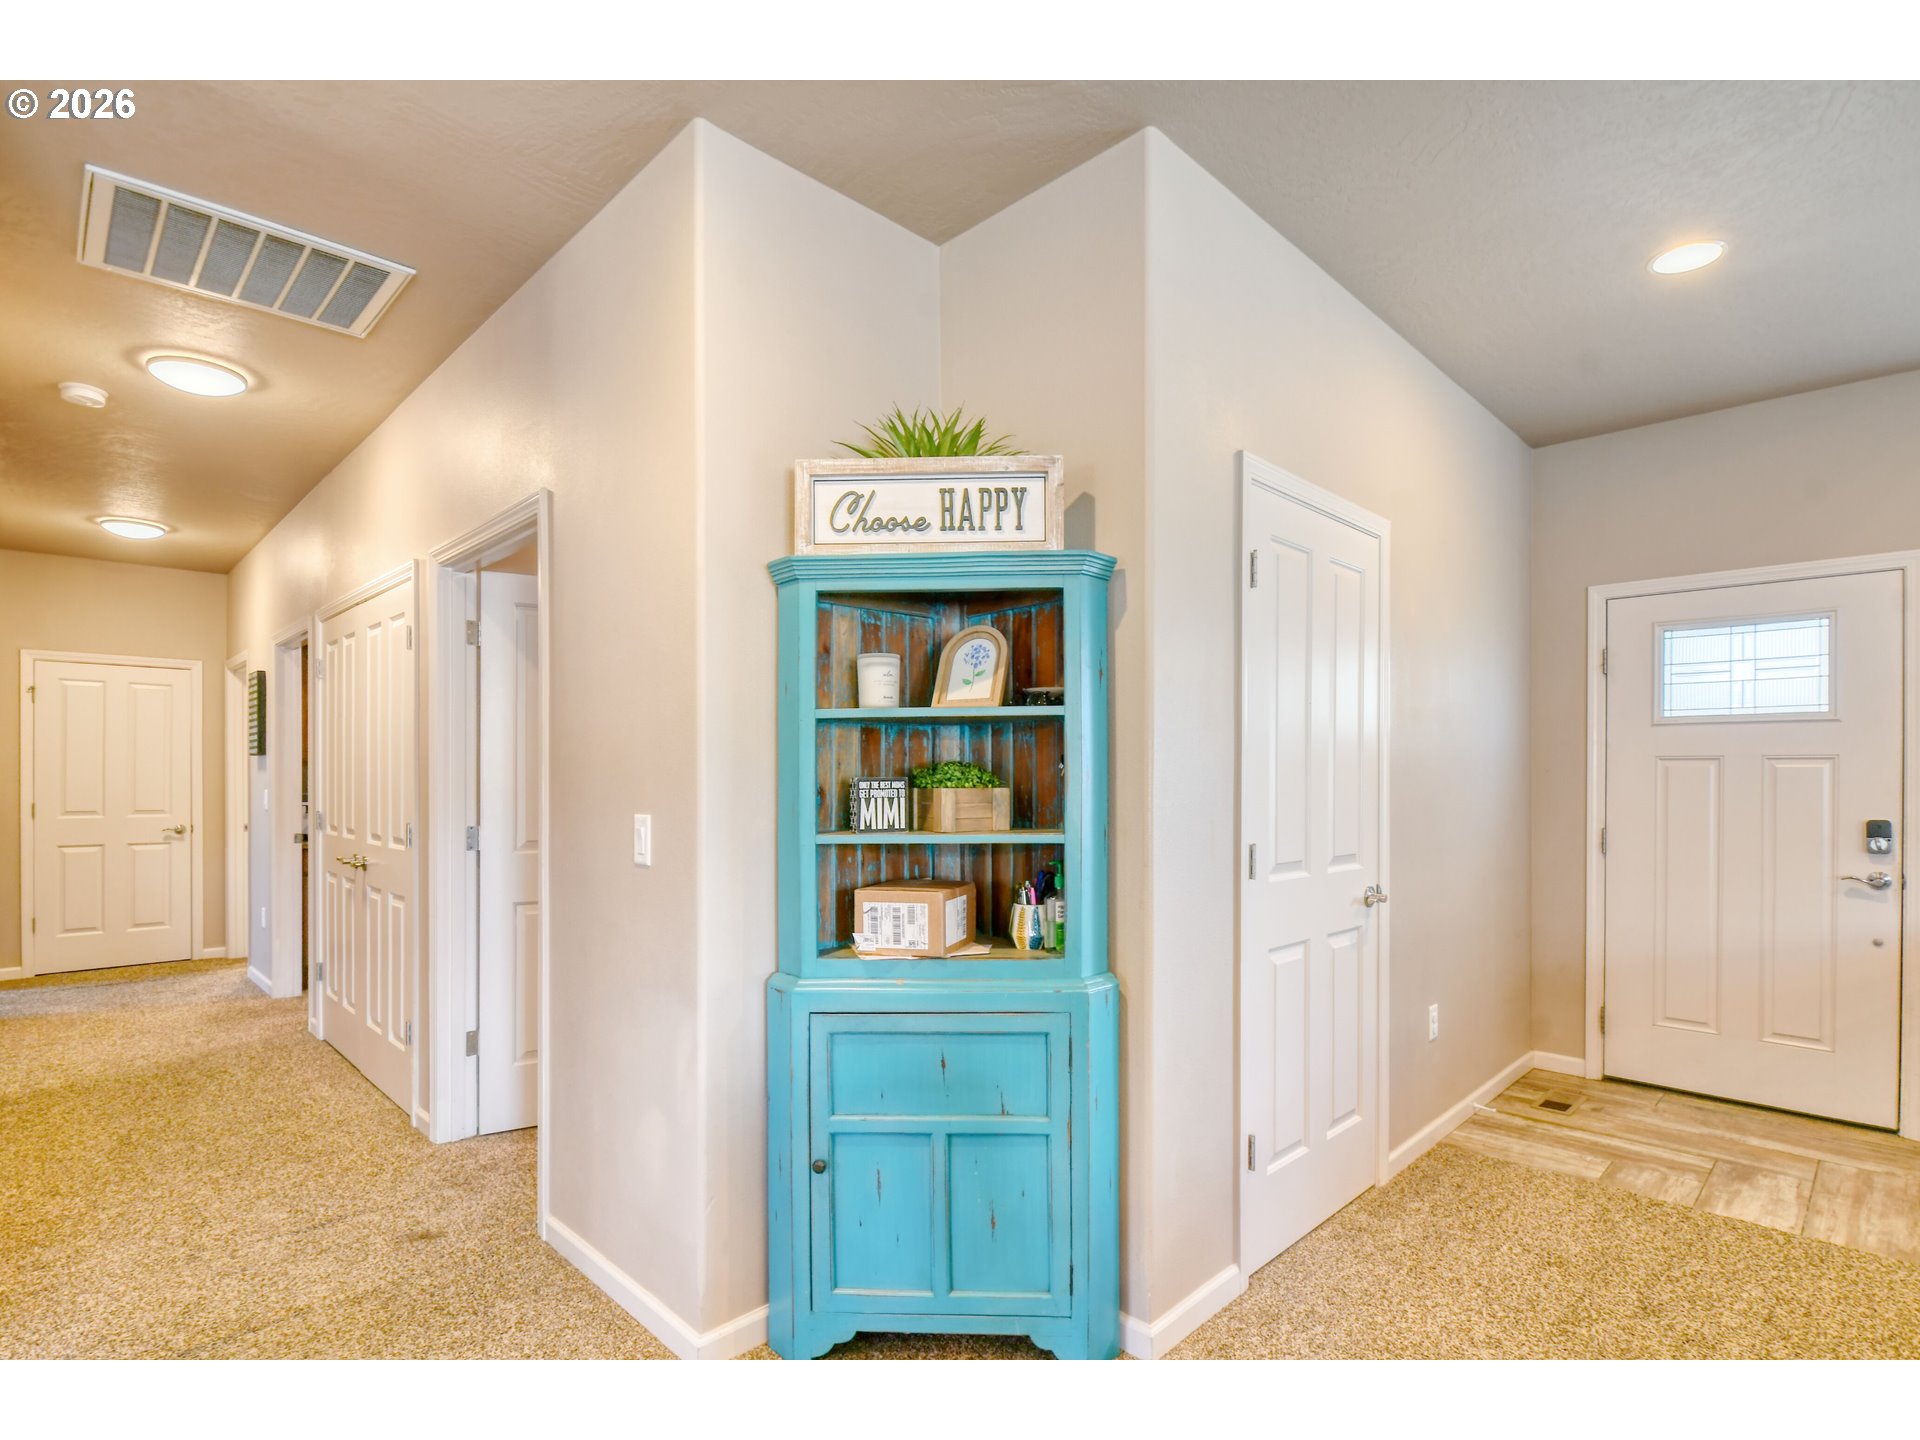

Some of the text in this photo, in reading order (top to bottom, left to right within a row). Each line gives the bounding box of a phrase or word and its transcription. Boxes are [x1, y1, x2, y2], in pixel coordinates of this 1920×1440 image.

[829, 487, 1028, 534] Choose HAPPY
[859, 789, 869, 798] GET
[859, 797, 906, 830] MIMI
